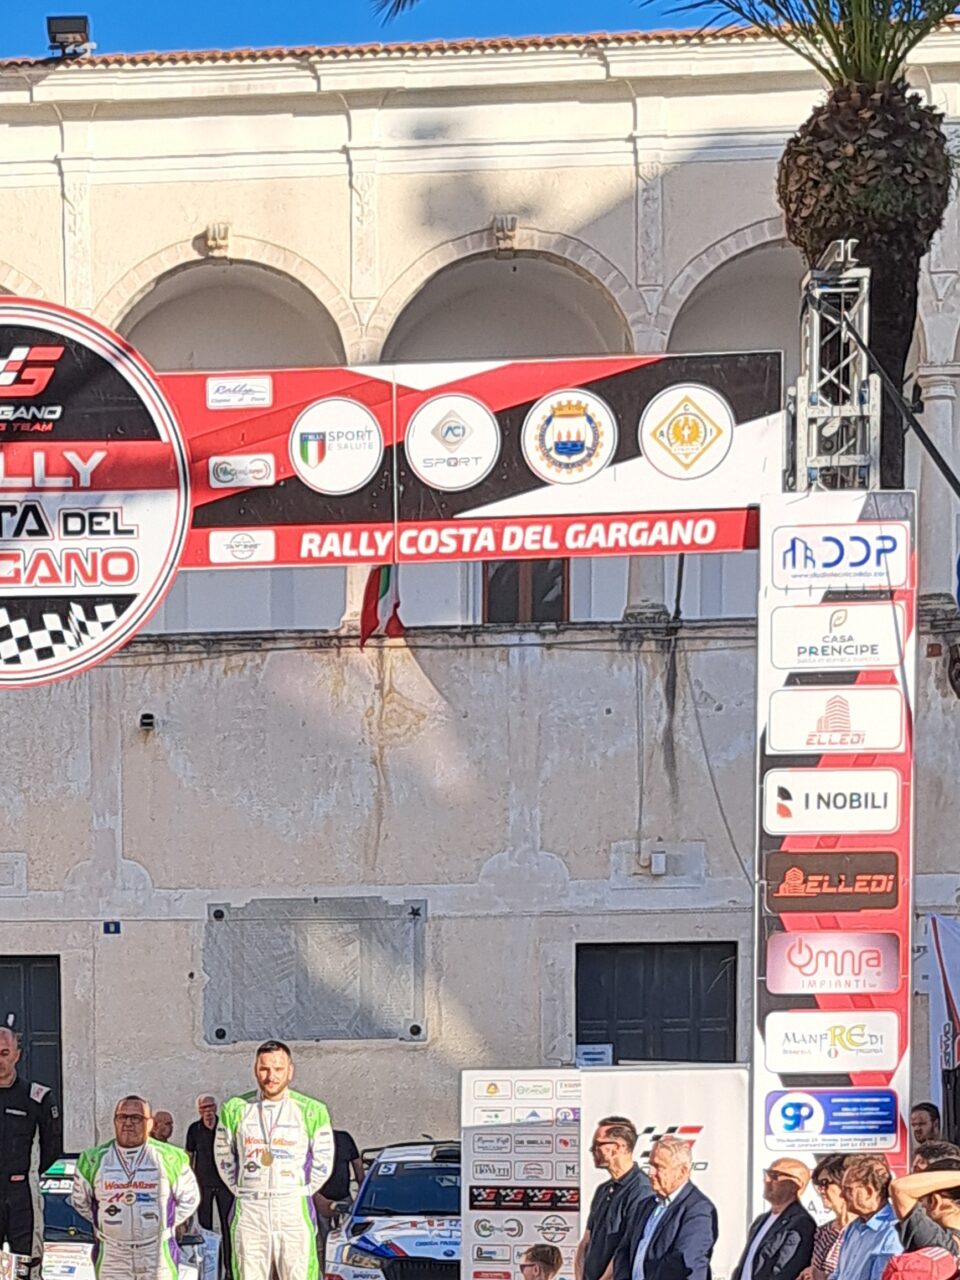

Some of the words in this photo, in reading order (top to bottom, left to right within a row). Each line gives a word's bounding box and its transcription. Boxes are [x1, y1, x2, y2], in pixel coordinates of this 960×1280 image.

[11, 421, 53, 433] TEAM
[328, 430, 374, 442] SPORT
[336, 442, 374, 451] SALUTE
[422, 456, 482, 468] SPORT
[62, 509, 136, 537] DEL
[300, 530, 393, 558] RALLY
[399, 526, 496, 555] COSTA
[501, 525, 559, 552] DEL
[565, 518, 717, 550] GARGANO
[821, 634, 855, 643] CASA
[796, 644, 880, 657] PRENCIPE
[804, 792, 809, 810] I
[816, 792, 888, 810] NOBILI
[801, 979, 867, 988] IMPIANTI
[381, 1163, 392, 1174] 5
